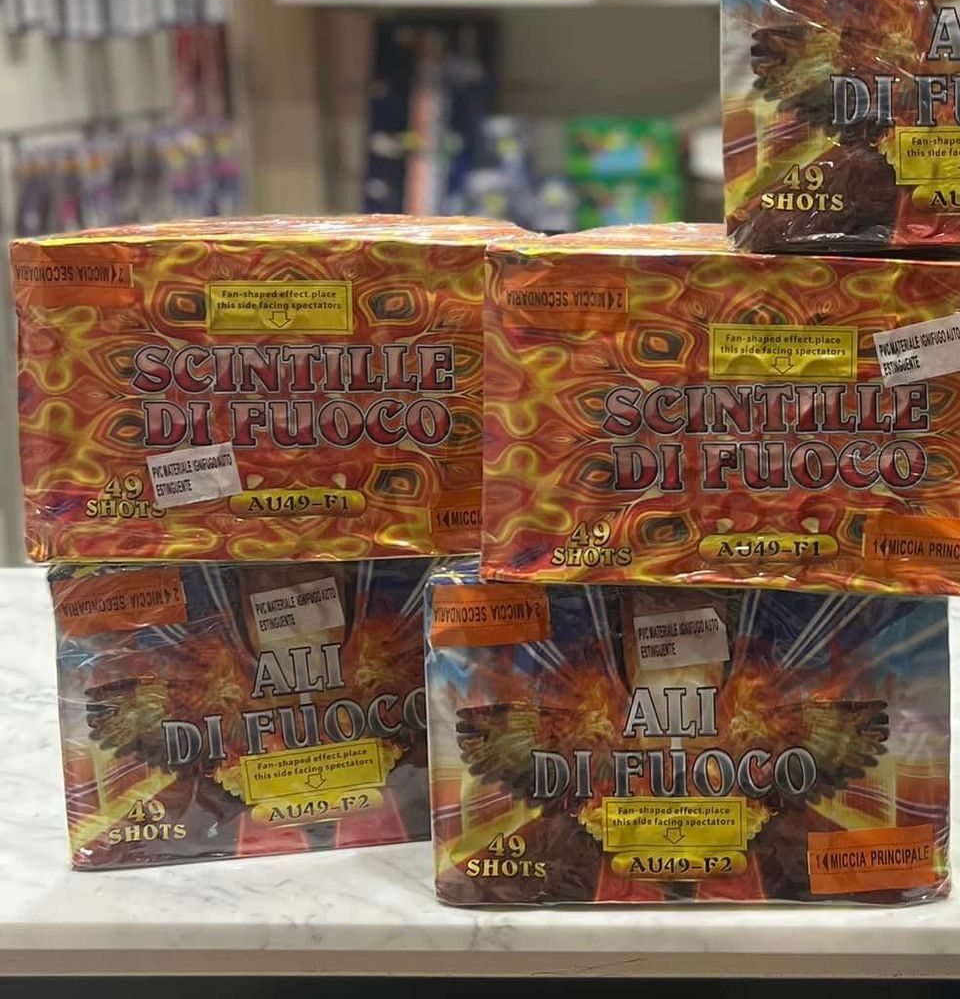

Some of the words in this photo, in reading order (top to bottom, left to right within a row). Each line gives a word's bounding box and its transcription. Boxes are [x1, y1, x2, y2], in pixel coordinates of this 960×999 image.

[830, 72, 896, 128] DI
[907, 148, 926, 157] this
[927, 148, 947, 157] side
[782, 164, 825, 191] 49
[761, 192, 844, 212] SHOTS
[15, 265, 74, 282] SECONDARIA
[76, 266, 110, 282] MICCIA
[221, 290, 278, 301] Fan-shaped
[507, 289, 568, 307] SECONDARIA
[217, 301, 236, 310] this
[237, 301, 257, 310] side
[259, 301, 289, 312] facing
[291, 302, 341, 312] spectators
[725, 333, 781, 345] Fan-shaped
[919, 331, 947, 350] IGNIFUGO
[946, 326, 960, 342] AUTO
[720, 345, 739, 354] this
[740, 345, 760, 354] side
[761, 346, 793, 357] facing
[795, 346, 846, 357] spectators
[130, 344, 456, 395] SCINTILLE
[601, 382, 930, 436] SCINTILLE
[142, 400, 214, 448] DI
[229, 398, 454, 448] FUOCO
[611, 442, 684, 493] DI
[700, 439, 927, 491] FUOCO
[103, 474, 144, 499] 49
[85, 499, 167, 519] SHOTS
[248, 495, 349, 512] AU49-F1
[451, 509, 483, 526] MICCI
[570, 519, 611, 547] 49
[551, 547, 632, 566] SHOTS
[717, 540, 821, 558] AU49-F1
[888, 539, 924, 556] MICCIA
[492, 604, 524, 620] MICCIA
[251, 643, 346, 699] ALI
[622, 686, 718, 739] ALI
[161, 714, 227, 766] DI
[254, 771, 273, 781] this
[273, 769, 293, 778] side
[294, 765, 323, 776] facing
[325, 758, 374, 772] spectators
[257, 756, 311, 770] Fan-shaped
[532, 750, 593, 799] DI
[612, 746, 818, 798] FUOCO
[127, 799, 166, 822] 49
[269, 794, 370, 822] AU49-F2
[617, 806, 673, 816] Fan-shaped
[613, 818, 632, 827] this
[633, 817, 653, 827] side
[654, 817, 683, 828] facing
[685, 818, 736, 828] spectators
[108, 823, 187, 845] SHOTS
[488, 832, 527, 858] 49
[628, 856, 734, 874] AU49-F2
[831, 852, 867, 869] MICCIA
[871, 845, 929, 865] PRINCIPALE
[466, 858, 547, 878] SHOTS
